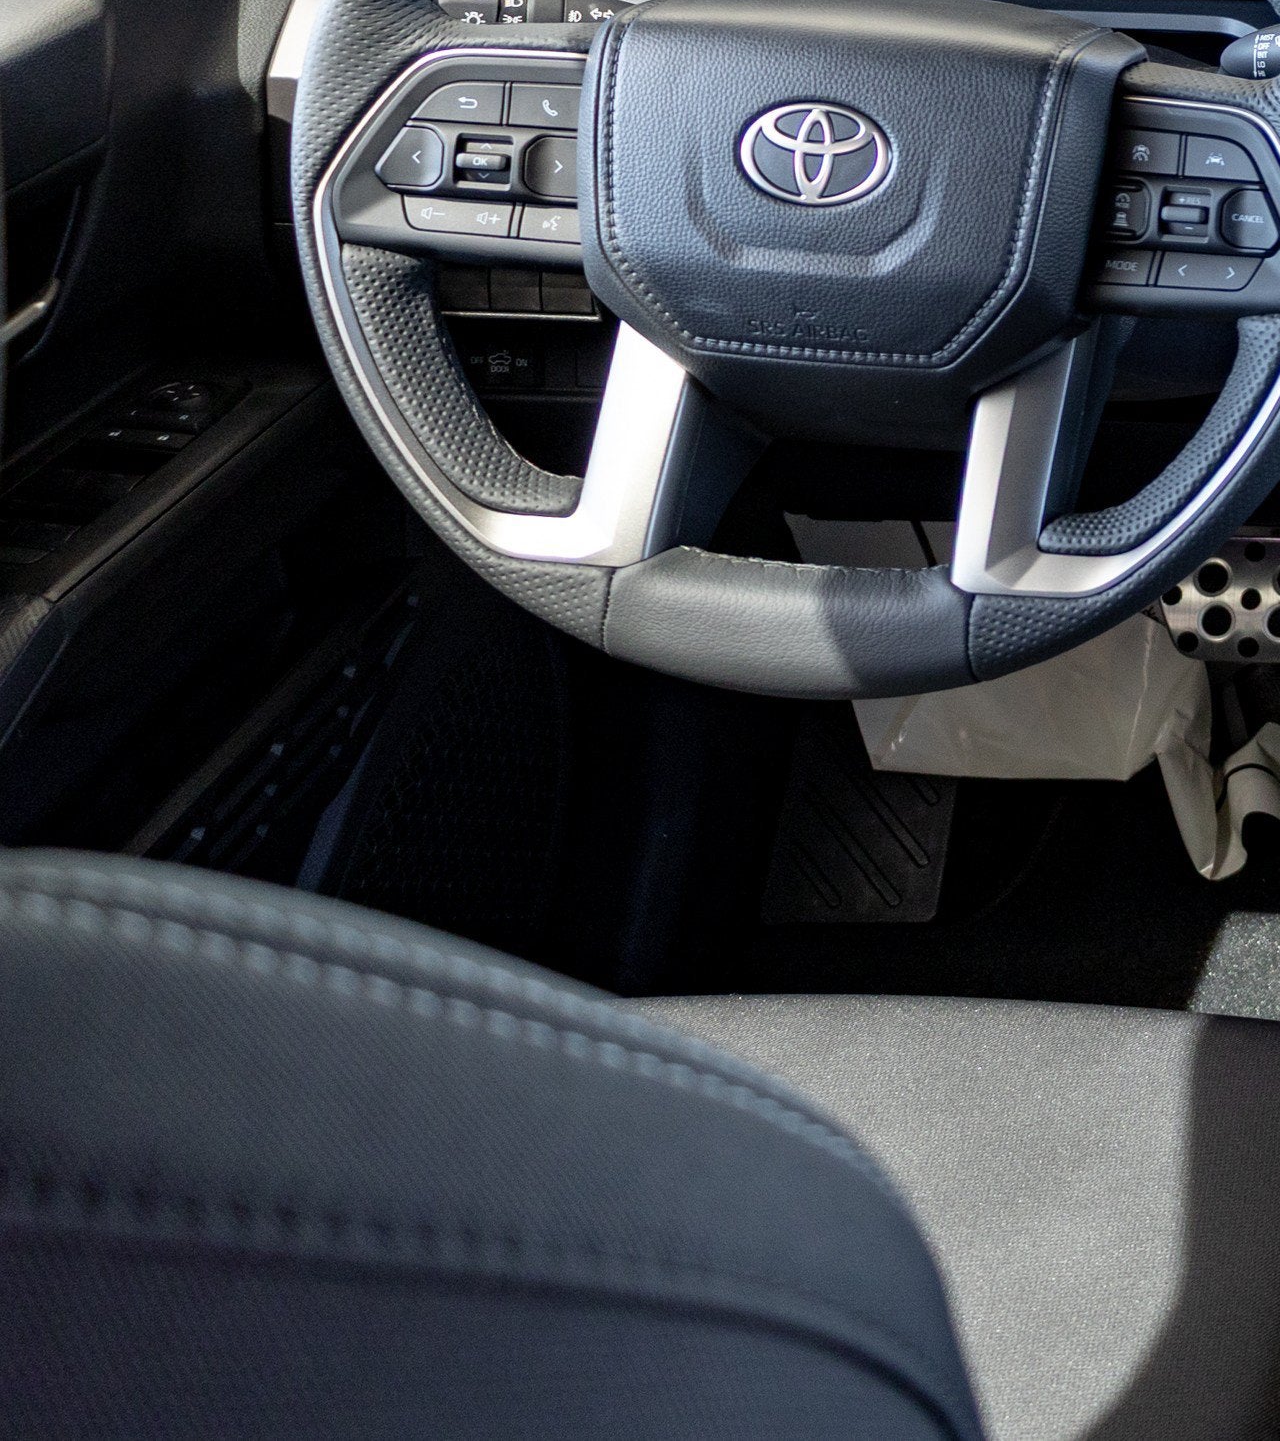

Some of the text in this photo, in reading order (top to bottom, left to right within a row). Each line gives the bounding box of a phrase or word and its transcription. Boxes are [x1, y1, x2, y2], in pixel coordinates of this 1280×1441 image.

[473, 156, 488, 166] OK
[1231, 213, 1265, 224] CANCEL
[1106, 260, 1138, 272] MODE
